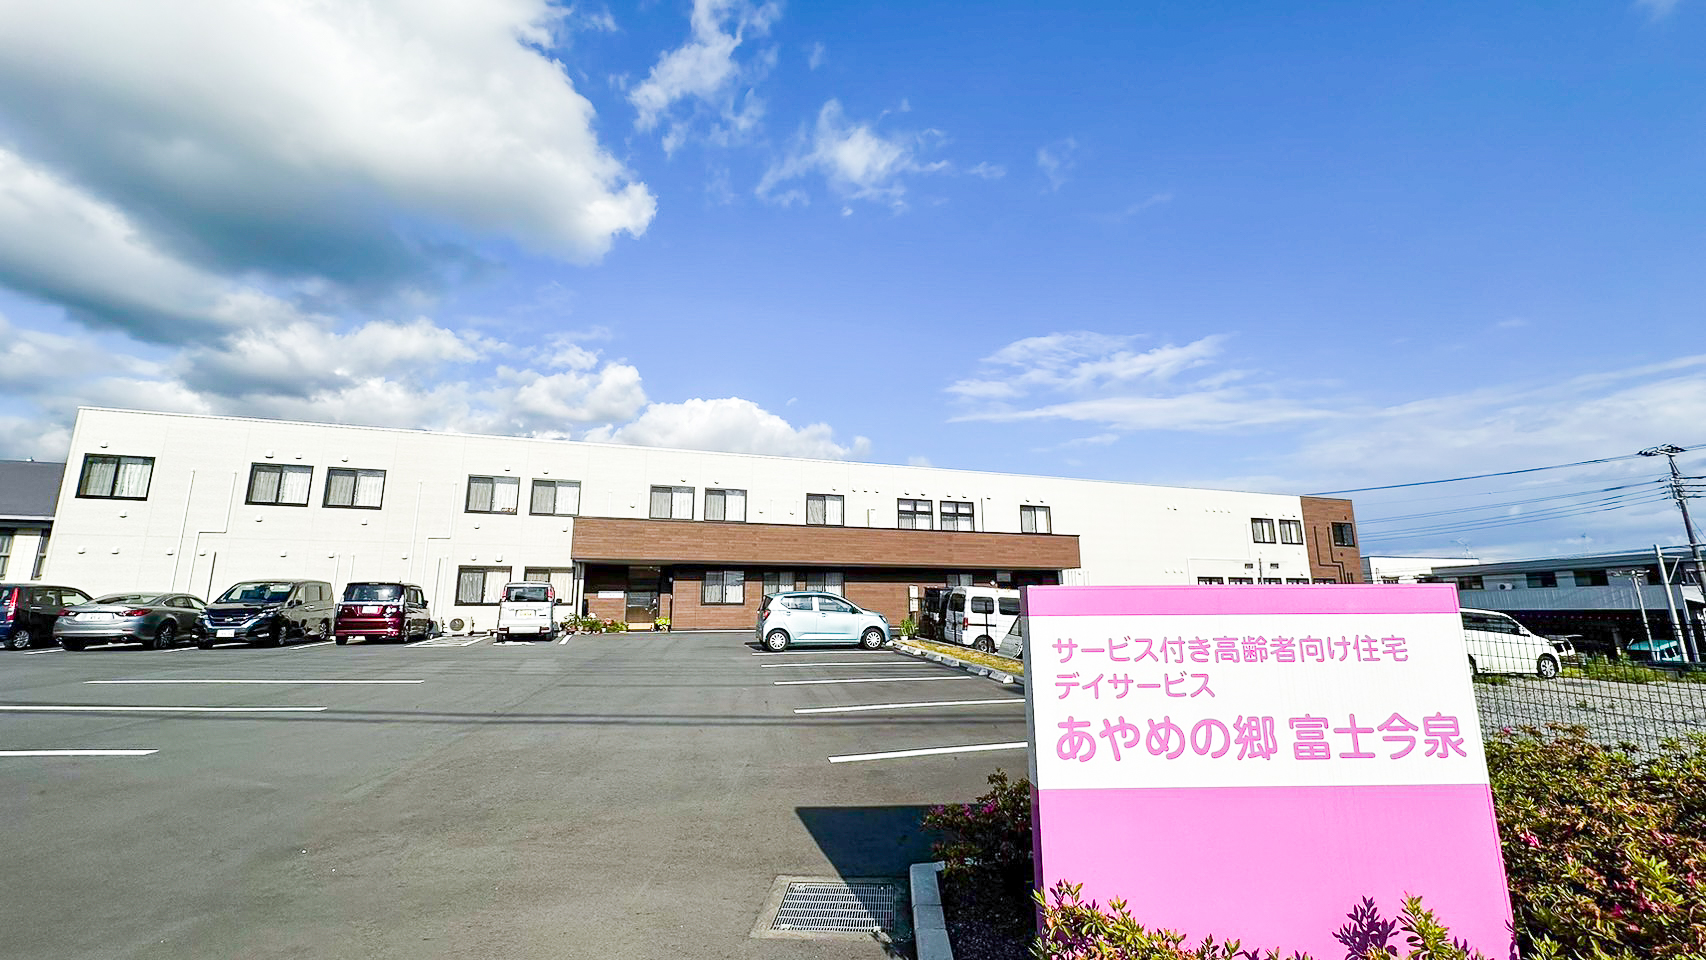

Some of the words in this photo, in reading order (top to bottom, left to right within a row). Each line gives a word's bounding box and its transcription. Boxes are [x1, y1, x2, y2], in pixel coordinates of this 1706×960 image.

[1052, 634, 1409, 664] サービス付き高齢者向け住宅
[1055, 672, 1216, 701] デイサービス
[1056, 714, 1278, 763] あやめの郷
[1288, 711, 1468, 761] 富士今泉
